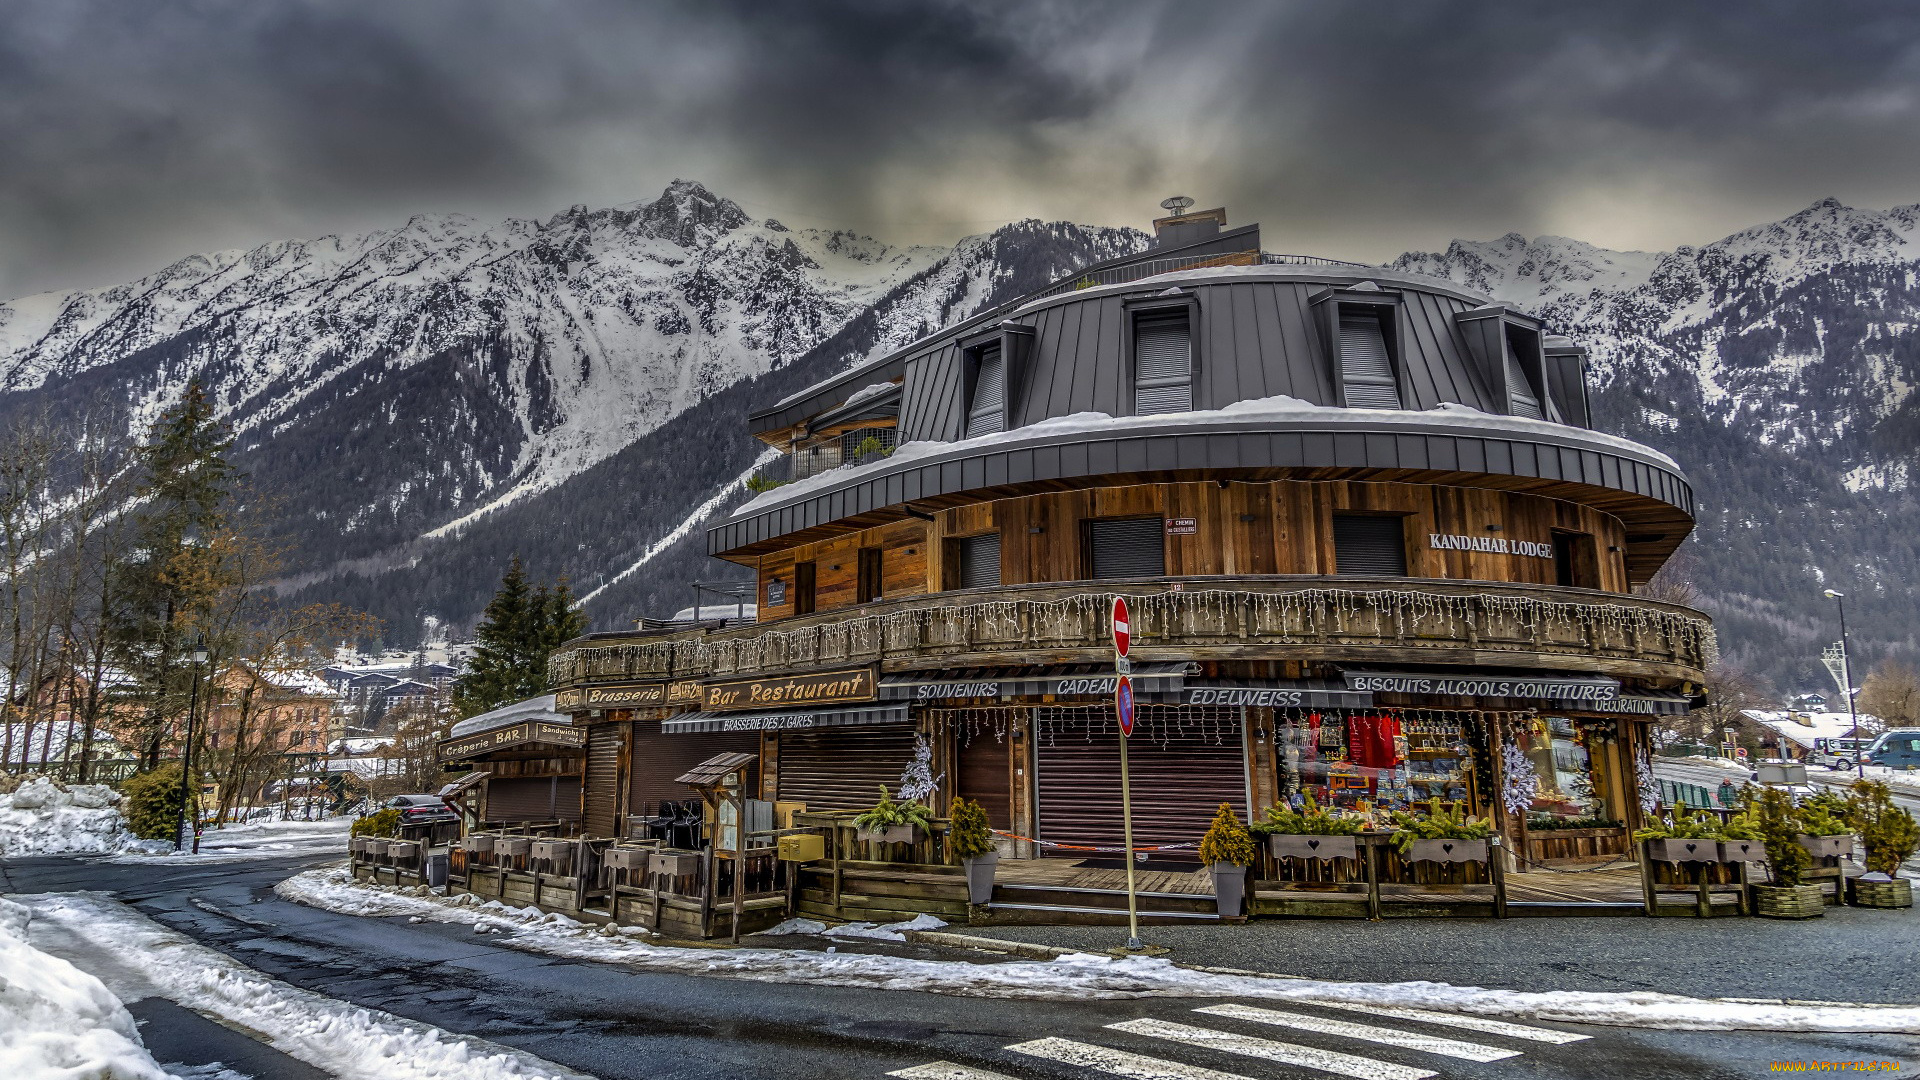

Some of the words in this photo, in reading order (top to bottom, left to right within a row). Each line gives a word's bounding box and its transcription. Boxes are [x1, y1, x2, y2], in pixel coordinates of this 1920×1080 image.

[1429, 533, 1509, 554] KANDAHAR
[1510, 539, 1553, 559] LODGE
[589, 688, 661, 703] Brasserie
[709, 687, 740, 706] Bar
[750, 673, 864, 702] Restaurant
[917, 682, 998, 699] SOUVENIRS
[1057, 677, 1132, 695] CADEAU
[1189, 689, 1302, 707] EDELWEISS
[1354, 677, 1432, 693] BISCUITS
[1436, 680, 1510, 697] ALCOOLS
[1514, 682, 1615, 700] CONFITURES
[1595, 699, 1654, 714] DECORATION
[724, 717, 762, 732] BRASSERIE
[762, 717, 778, 730] DES
[778, 717, 785, 730] 2
[786, 714, 813, 729] GARES
[446, 739, 489, 756] Crêperie
[495, 729, 521, 745] BAR
